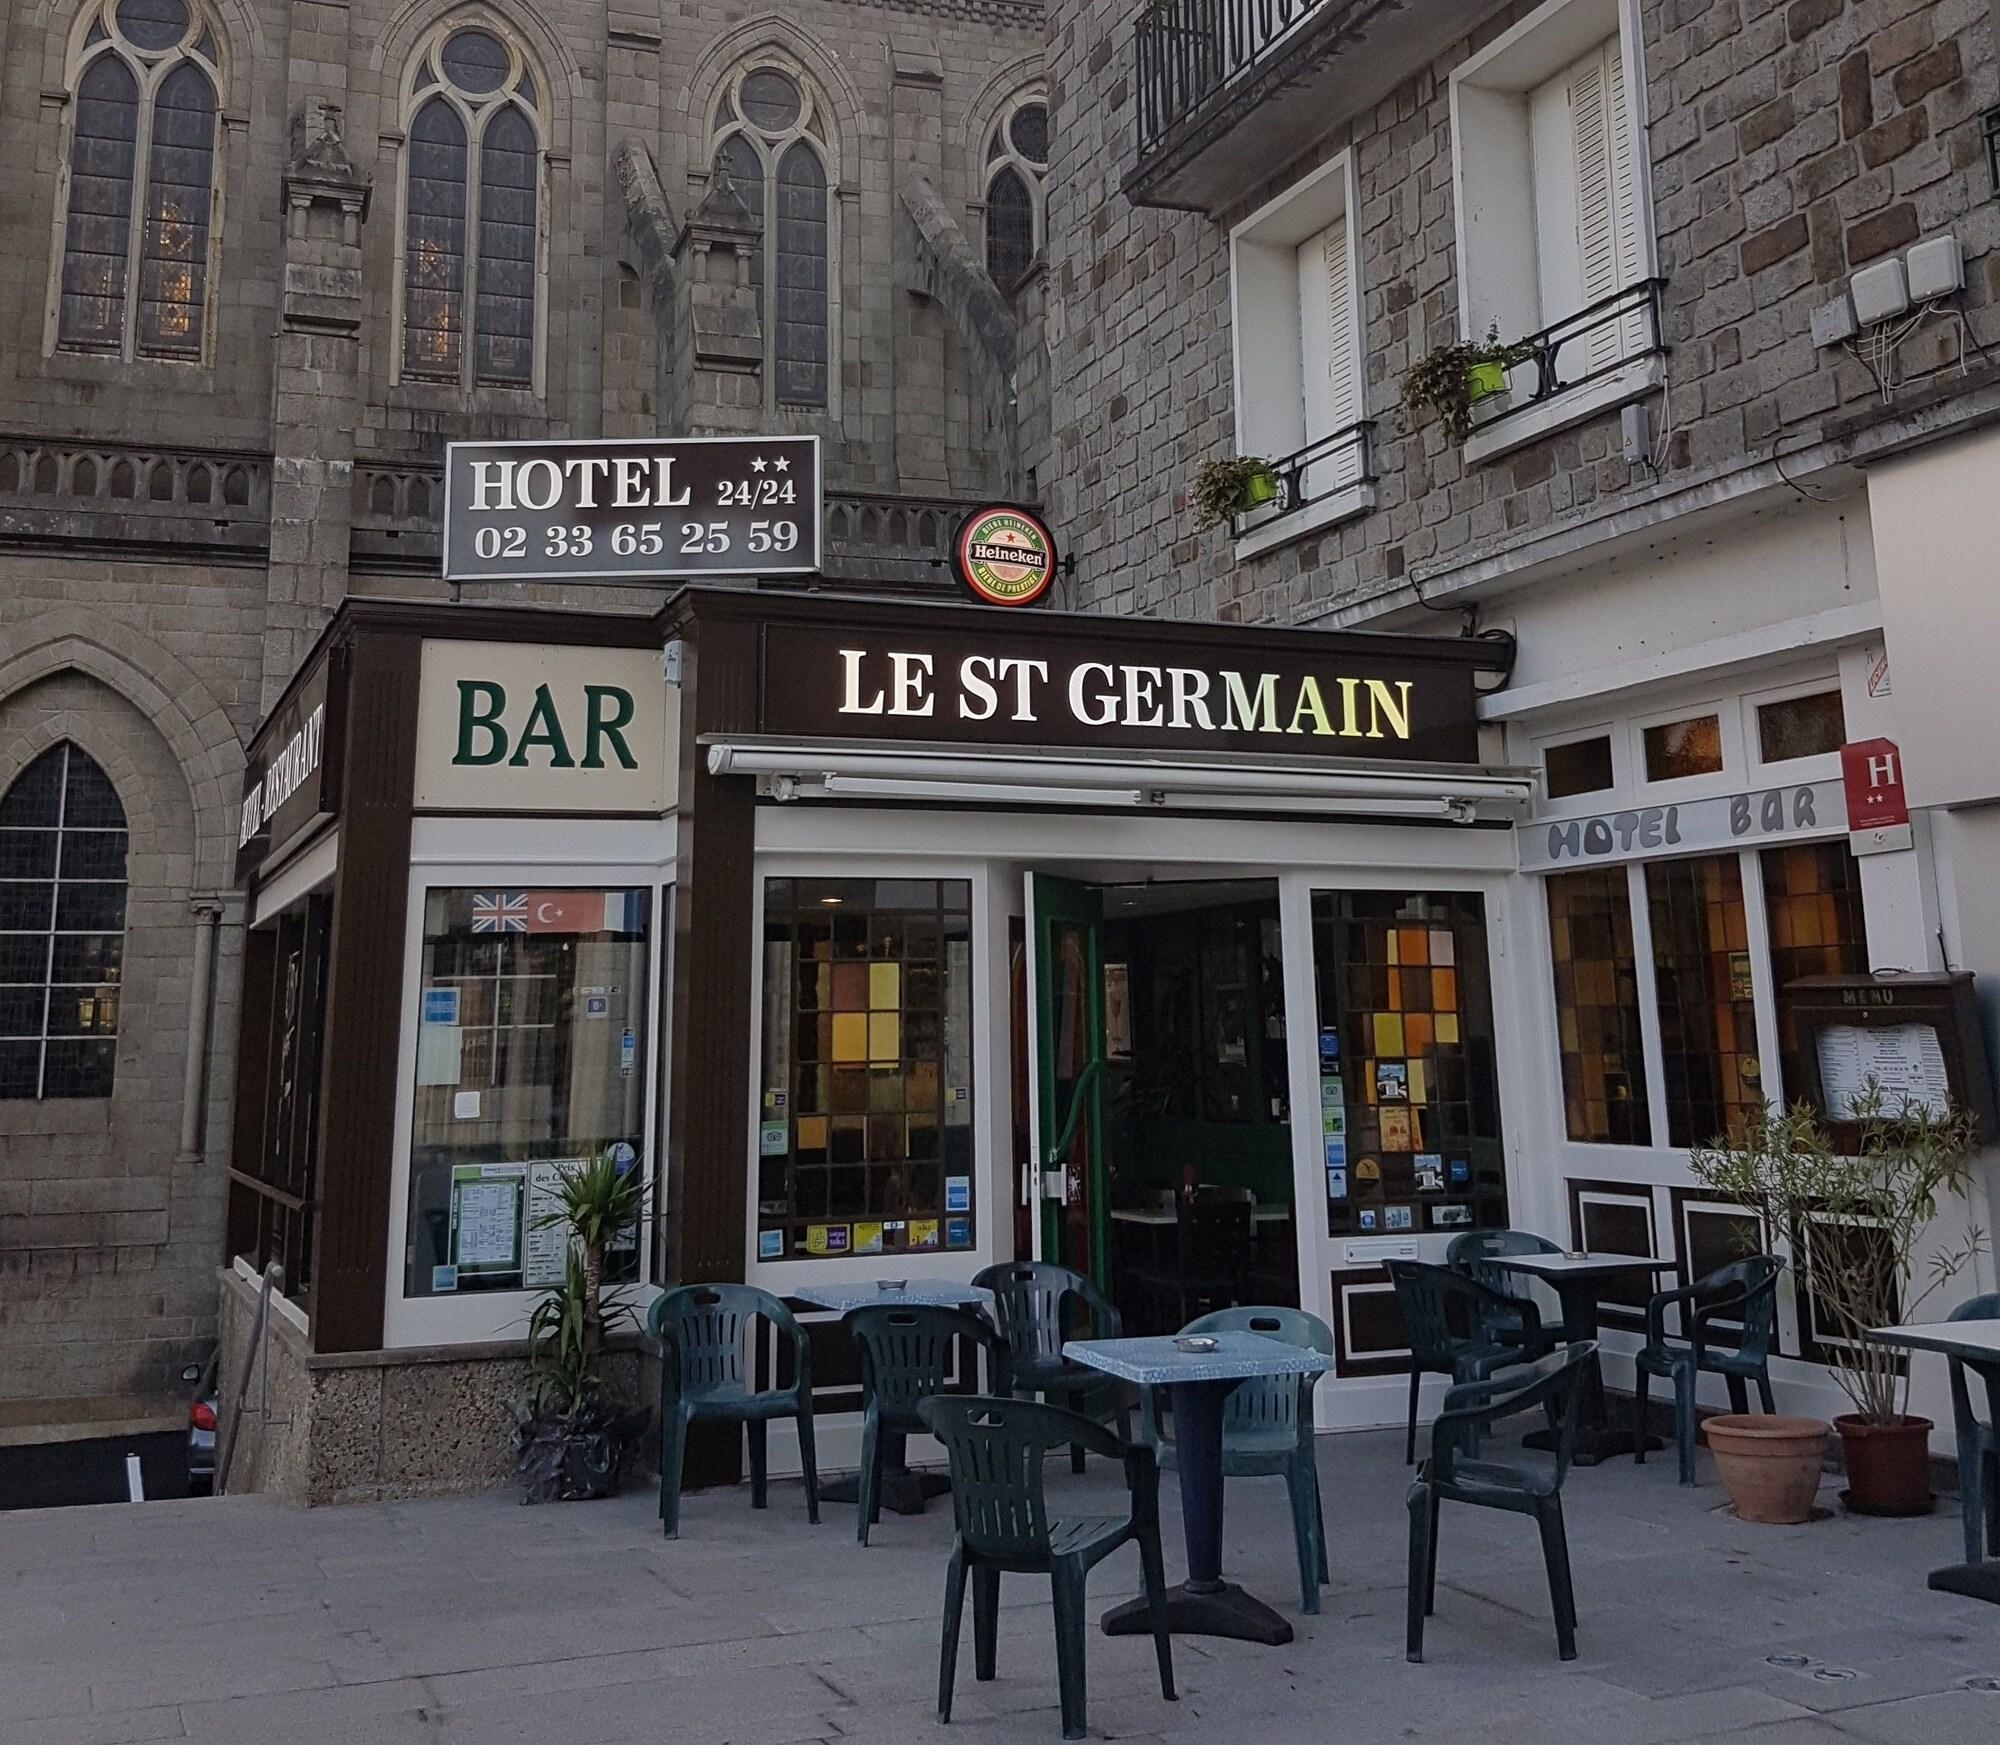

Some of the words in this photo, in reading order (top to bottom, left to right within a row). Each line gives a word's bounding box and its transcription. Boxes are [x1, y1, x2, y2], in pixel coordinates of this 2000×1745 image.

[468, 457, 692, 511] HOTEL
[717, 479, 797, 512] 24/24
[474, 527, 528, 559] 02
[544, 525, 594, 557] 33
[610, 523, 665, 555] 65
[680, 521, 731, 554] 25
[747, 520, 799, 553] 59
[974, 544, 1043, 566] Heineken
[1006, 573, 1038, 593] PRESTIGE
[838, 649, 934, 718] LE
[959, 655, 1048, 722] ST
[1067, 662, 1413, 740] GERMAIN
[452, 680, 639, 770] BAR
[263, 702, 323, 822] RESTAURANT
[1866, 752, 1898, 788] H
[1548, 806, 1682, 860] HOTEL
[1730, 787, 1816, 836] BAR
[1842, 988, 1894, 1005] MENU
